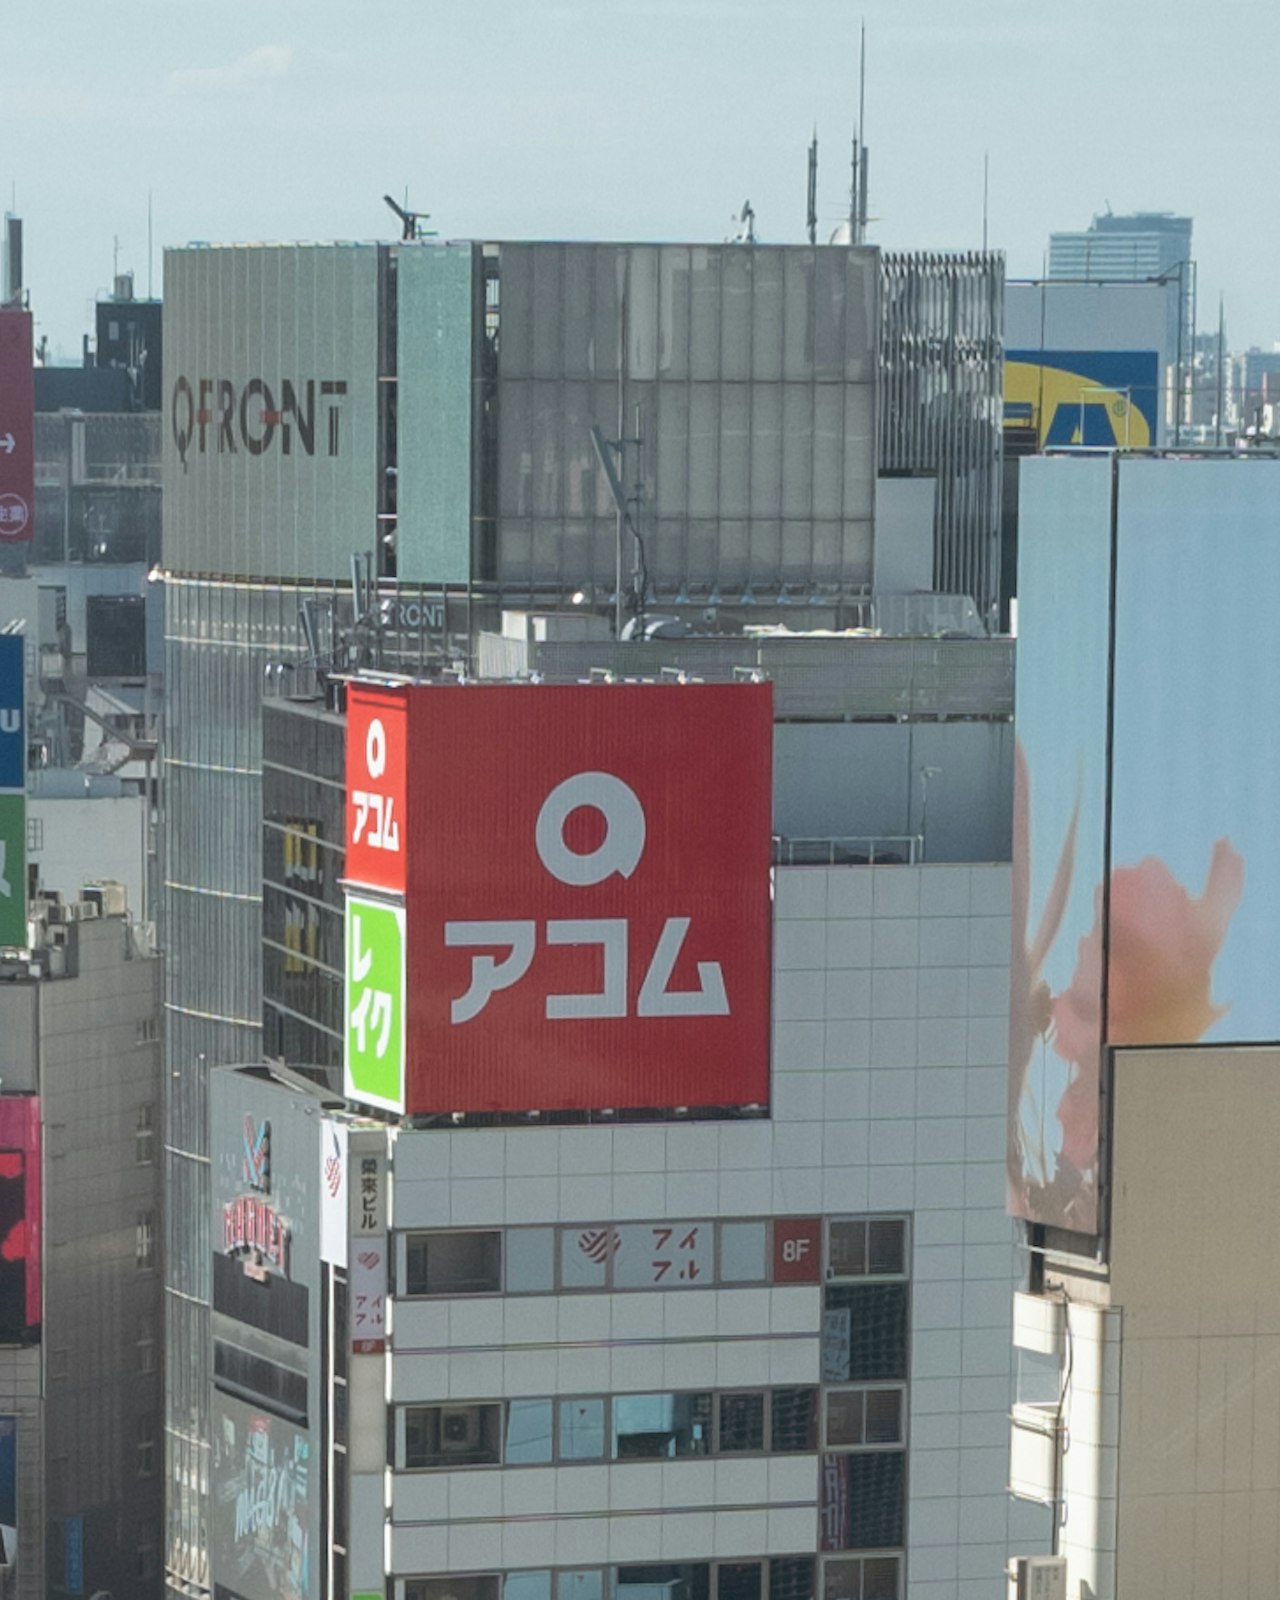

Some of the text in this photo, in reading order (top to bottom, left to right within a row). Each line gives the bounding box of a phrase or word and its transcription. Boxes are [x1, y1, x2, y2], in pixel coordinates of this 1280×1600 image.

[172, 375, 348, 474] QFRONT
[351, 791, 400, 852] アコム
[350, 914, 394, 1060] レイク
[444, 917, 732, 1026] アコム
[652, 1227, 699, 1250] アイ
[782, 1238, 810, 1263] 8F
[652, 1260, 701, 1283] フル
